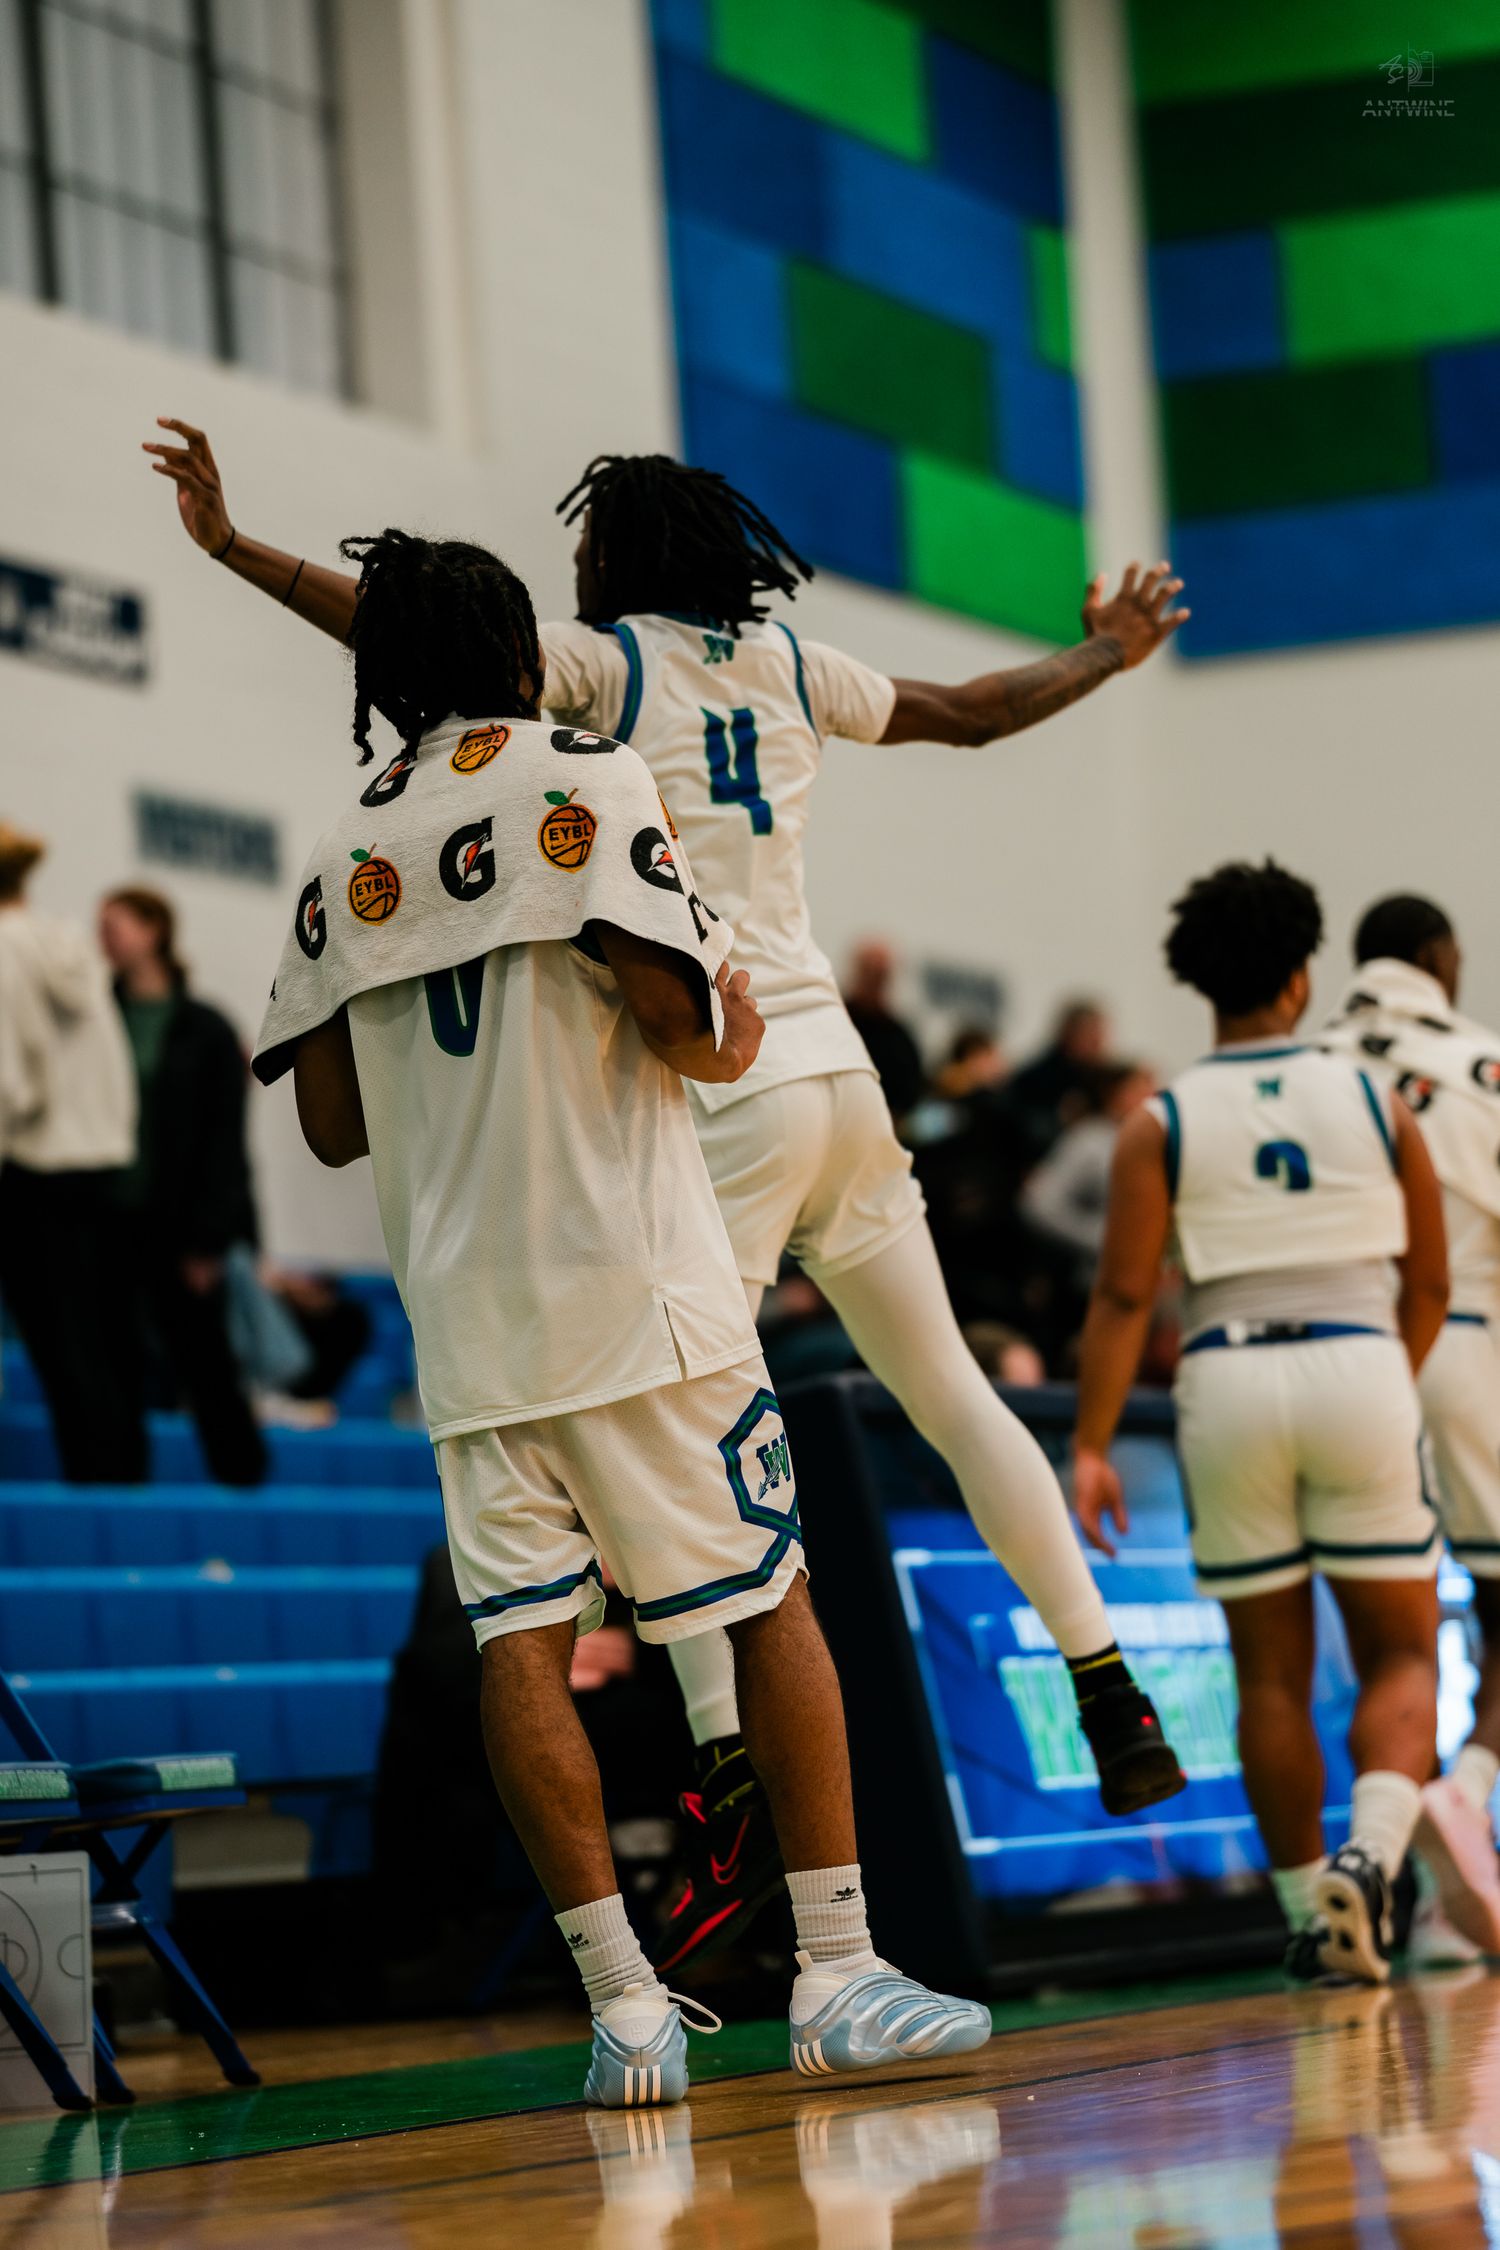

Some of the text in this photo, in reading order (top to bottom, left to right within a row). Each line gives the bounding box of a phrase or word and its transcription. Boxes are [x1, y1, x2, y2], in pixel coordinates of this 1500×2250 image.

[463, 735, 500, 753] EYBL
[700, 706, 773, 836] 4
[548, 823, 591, 841] EYBL
[439, 816, 496, 902] G
[355, 875, 393, 897] EYBL
